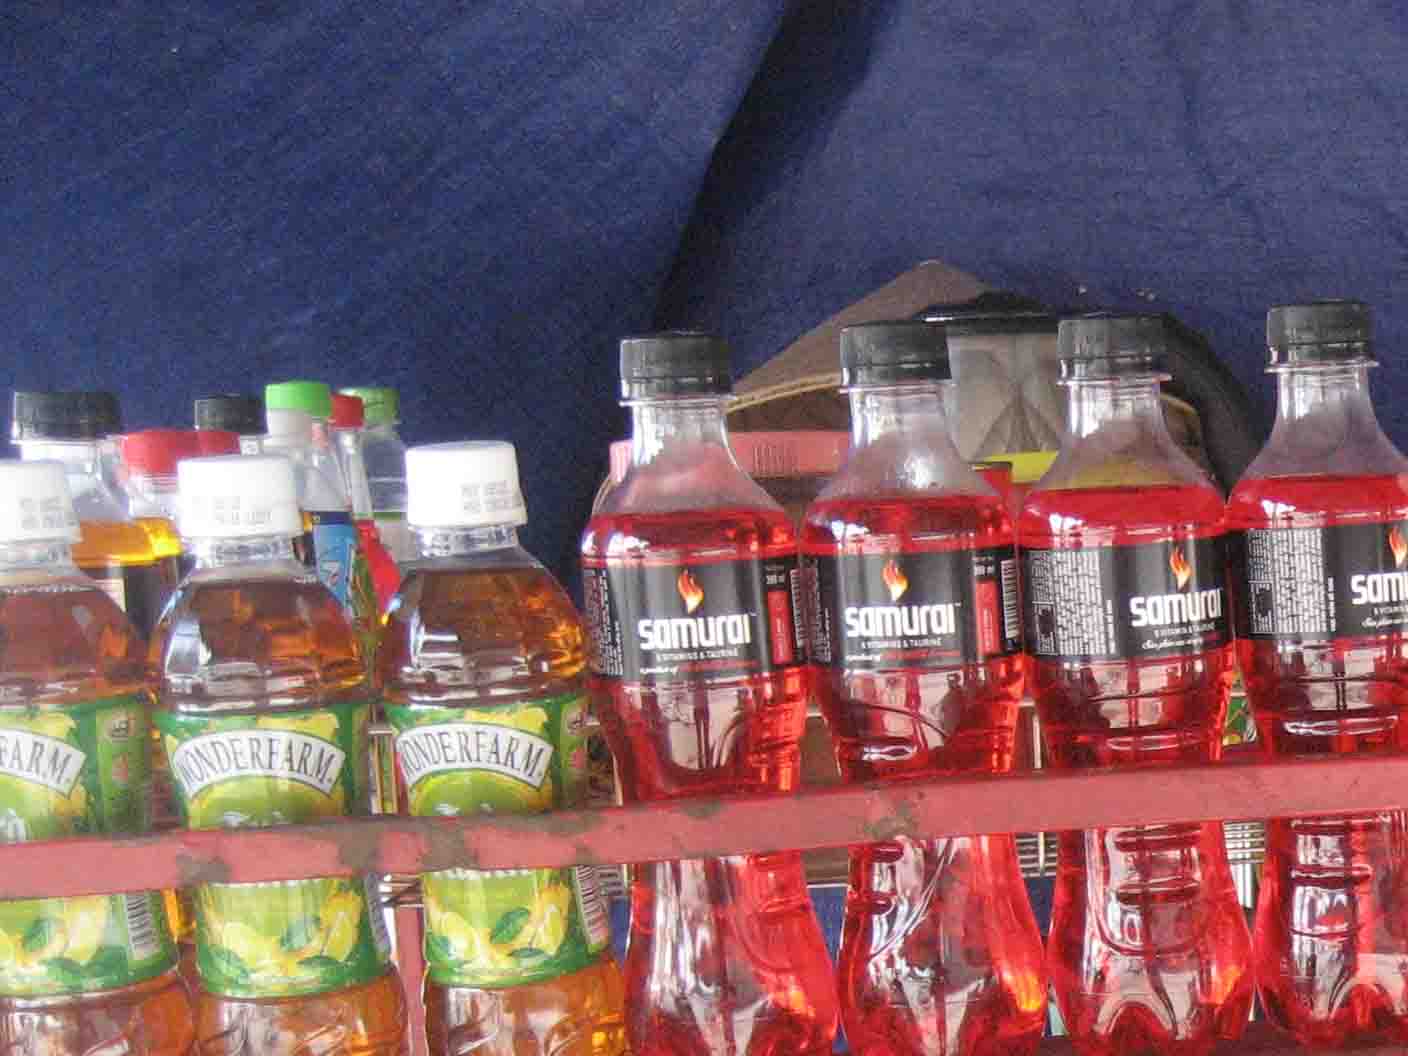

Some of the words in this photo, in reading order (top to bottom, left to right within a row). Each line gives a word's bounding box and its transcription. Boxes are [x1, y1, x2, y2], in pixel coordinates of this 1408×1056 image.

[844, 602, 956, 638] samurai
[1129, 588, 1222, 627] samurai
[637, 613, 751, 650] samurai
